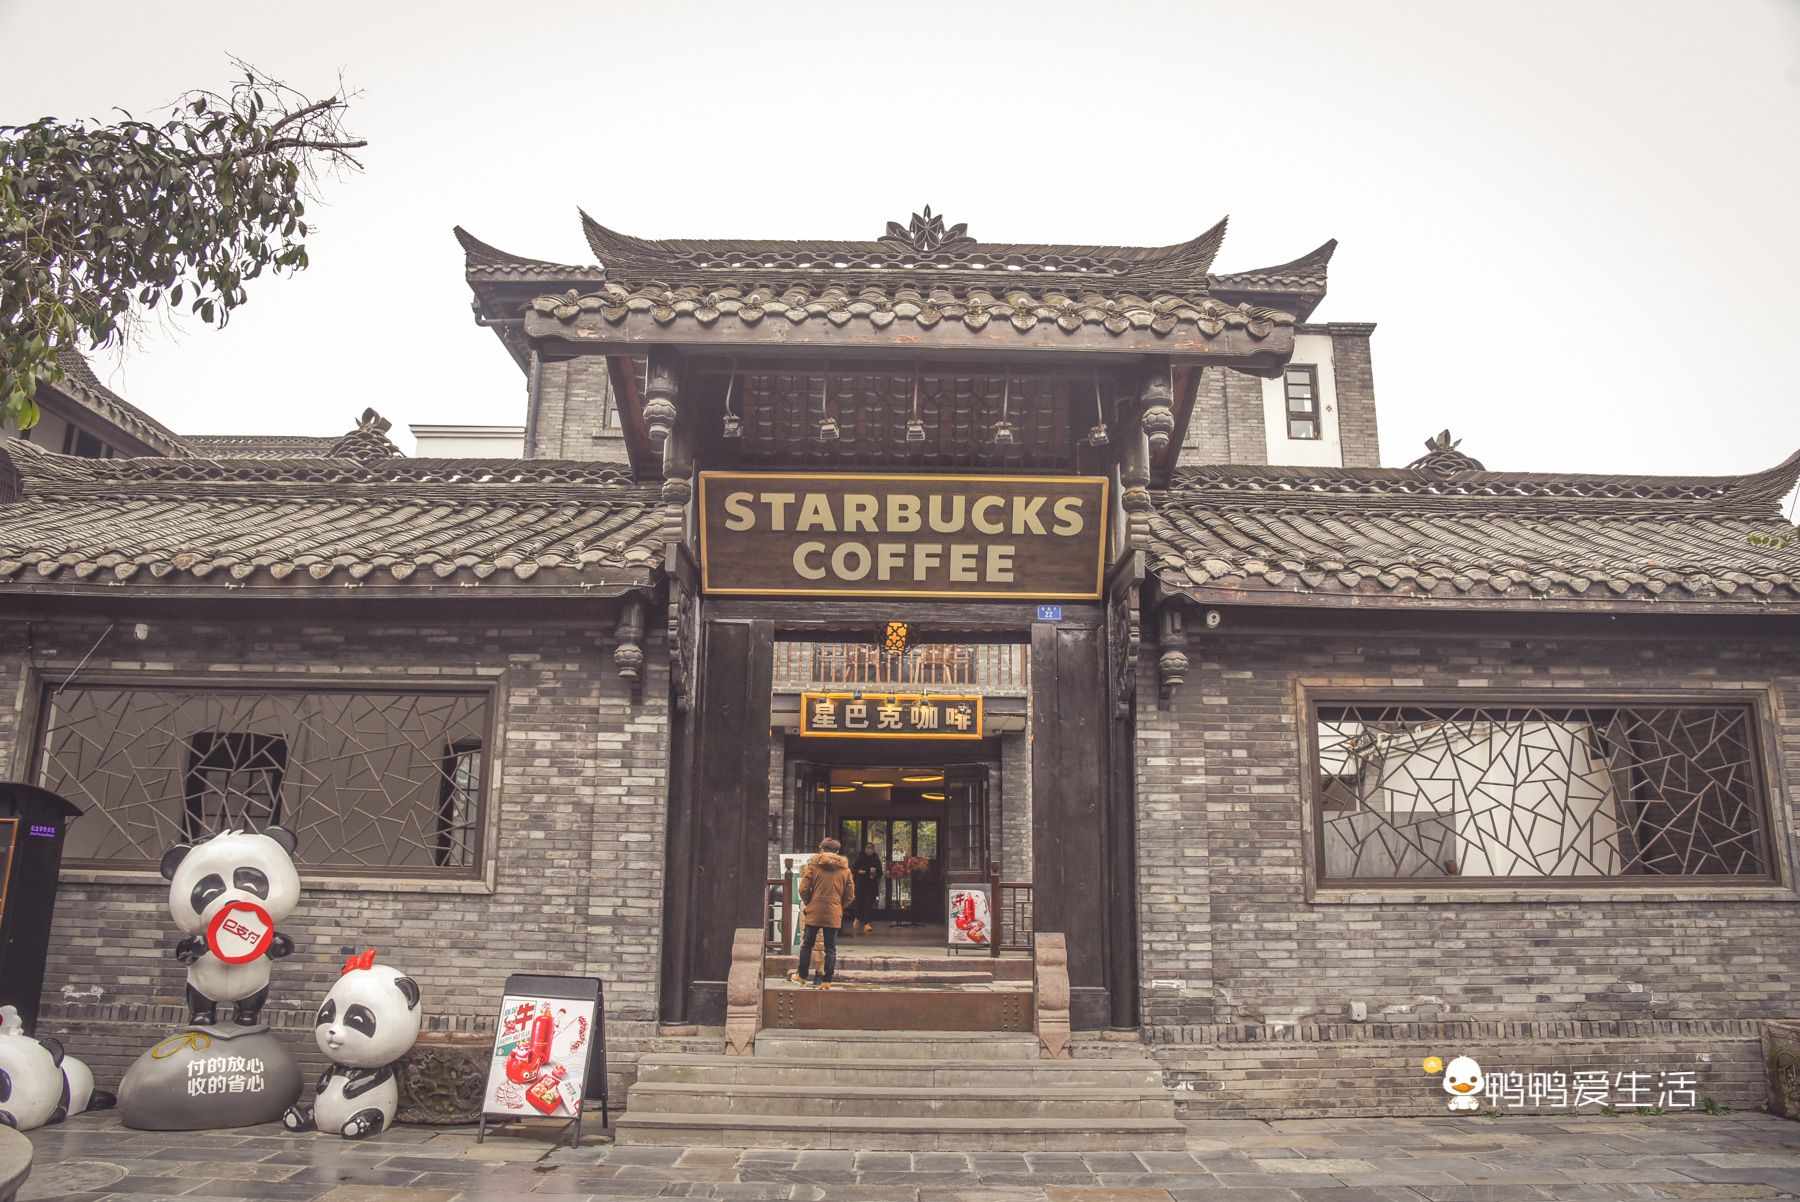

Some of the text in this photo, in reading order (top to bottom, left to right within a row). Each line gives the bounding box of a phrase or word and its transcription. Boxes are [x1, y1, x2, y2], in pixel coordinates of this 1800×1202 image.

[724, 491, 1085, 537] STARBUCKS
[792, 541, 1016, 583] COFFEE
[1044, 610, 1053, 618] 22
[812, 703, 972, 731] 星巴克咖啡
[222, 918, 261, 945] 已支付
[516, 1003, 535, 1031] 牛
[186, 1056, 265, 1077] 付的放心
[187, 1074, 265, 1097] 收的省心
